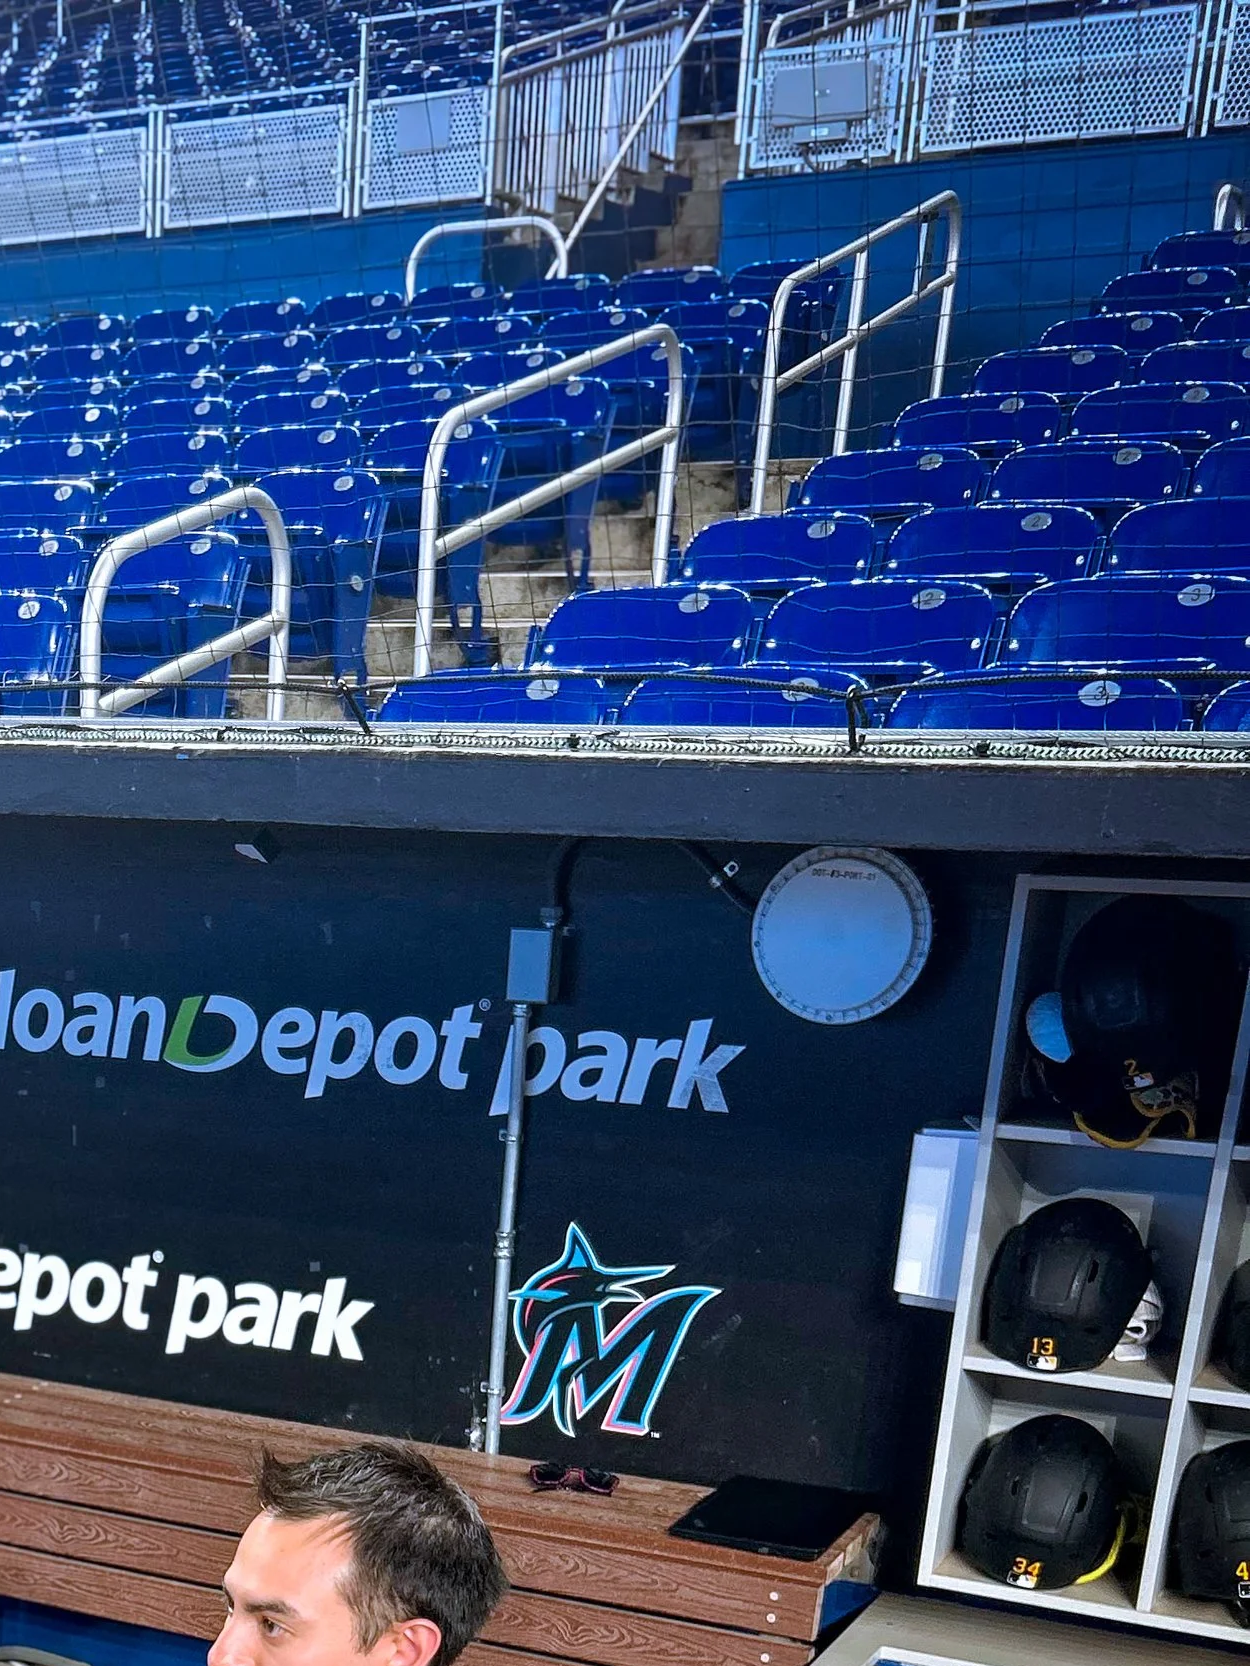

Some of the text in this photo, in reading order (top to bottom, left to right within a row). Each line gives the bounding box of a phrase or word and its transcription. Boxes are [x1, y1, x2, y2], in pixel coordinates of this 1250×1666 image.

[1031, 515, 1042, 528] 2
[923, 591, 935, 605] 2
[1190, 588, 1202, 602] 3
[1093, 685, 1106, 701] 3
[488, 1017, 747, 1114] park
[164, 1276, 376, 1362] park
[1031, 1336, 1054, 1356] 13
[1012, 1556, 1041, 1577] 34
